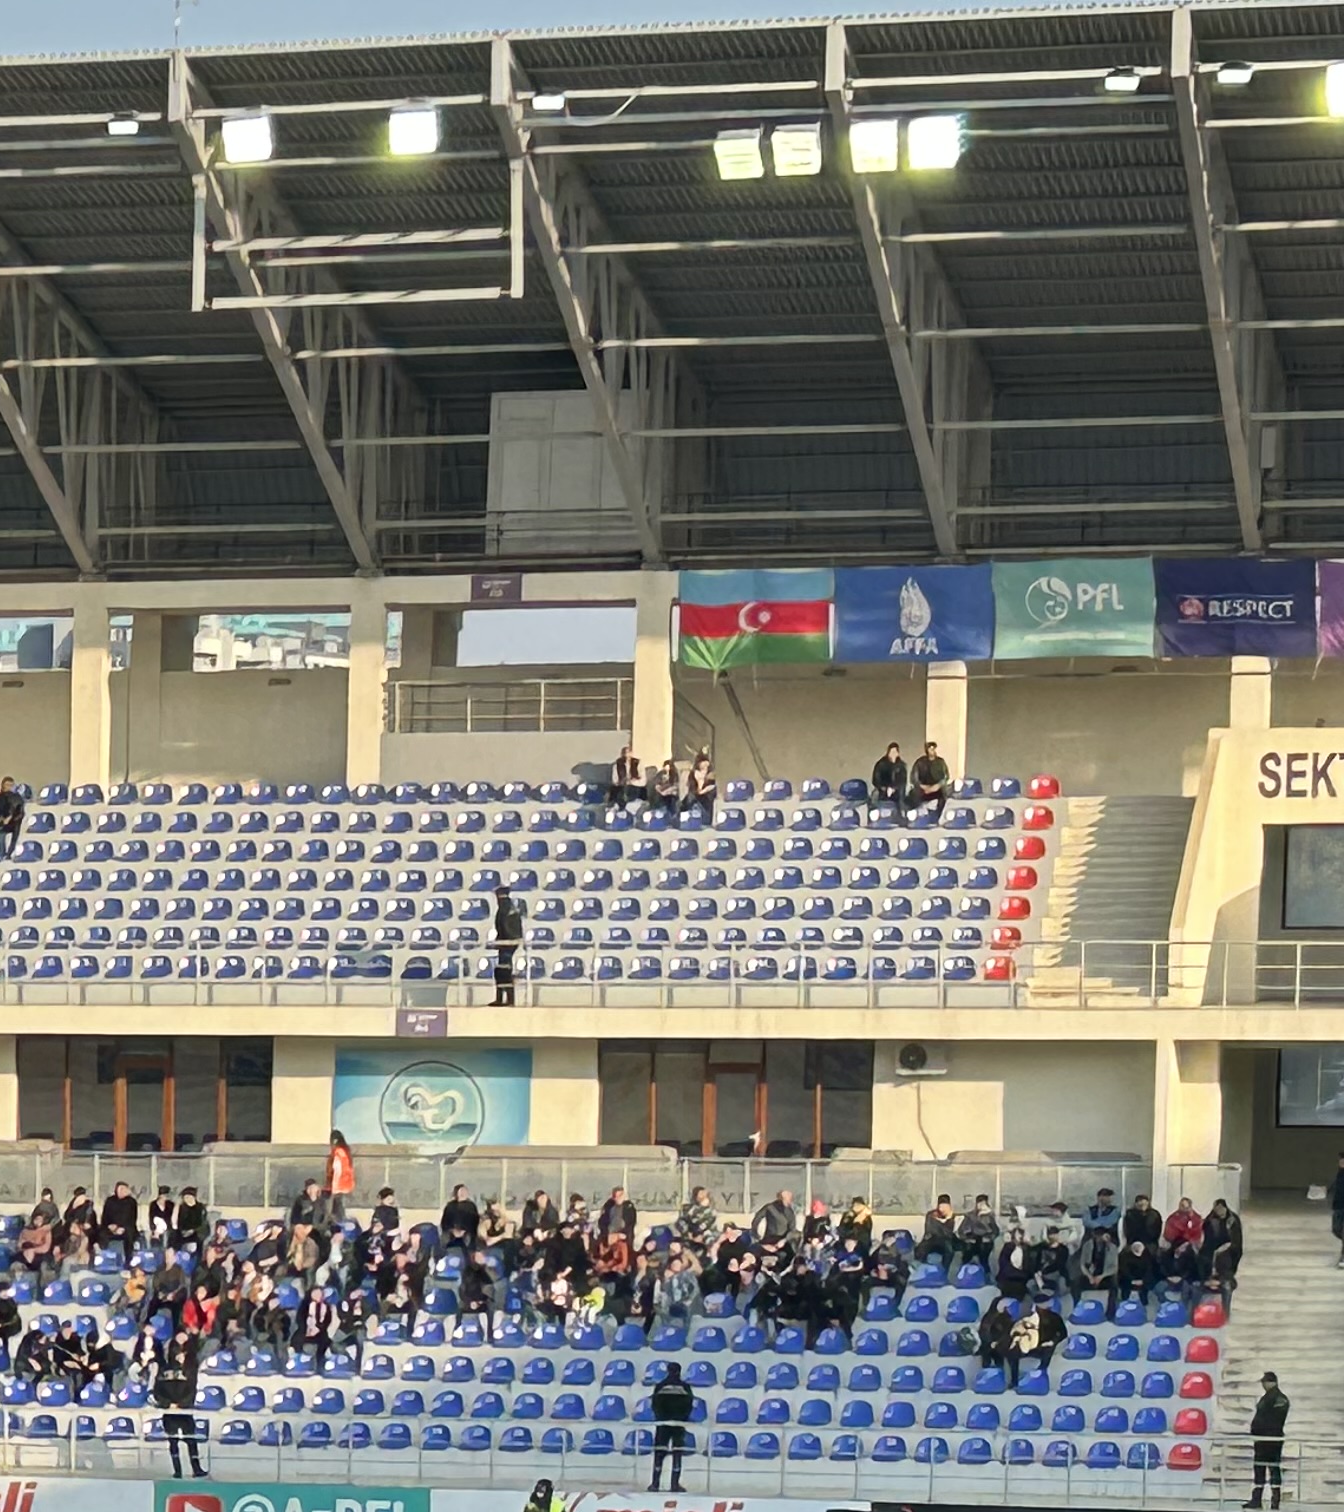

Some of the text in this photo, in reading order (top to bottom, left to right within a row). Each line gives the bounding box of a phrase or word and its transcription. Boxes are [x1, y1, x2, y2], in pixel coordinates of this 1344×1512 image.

[1076, 582, 1124, 611] PFL
[1208, 599, 1294, 618] RESPECT
[1257, 751, 1344, 799] SEK
